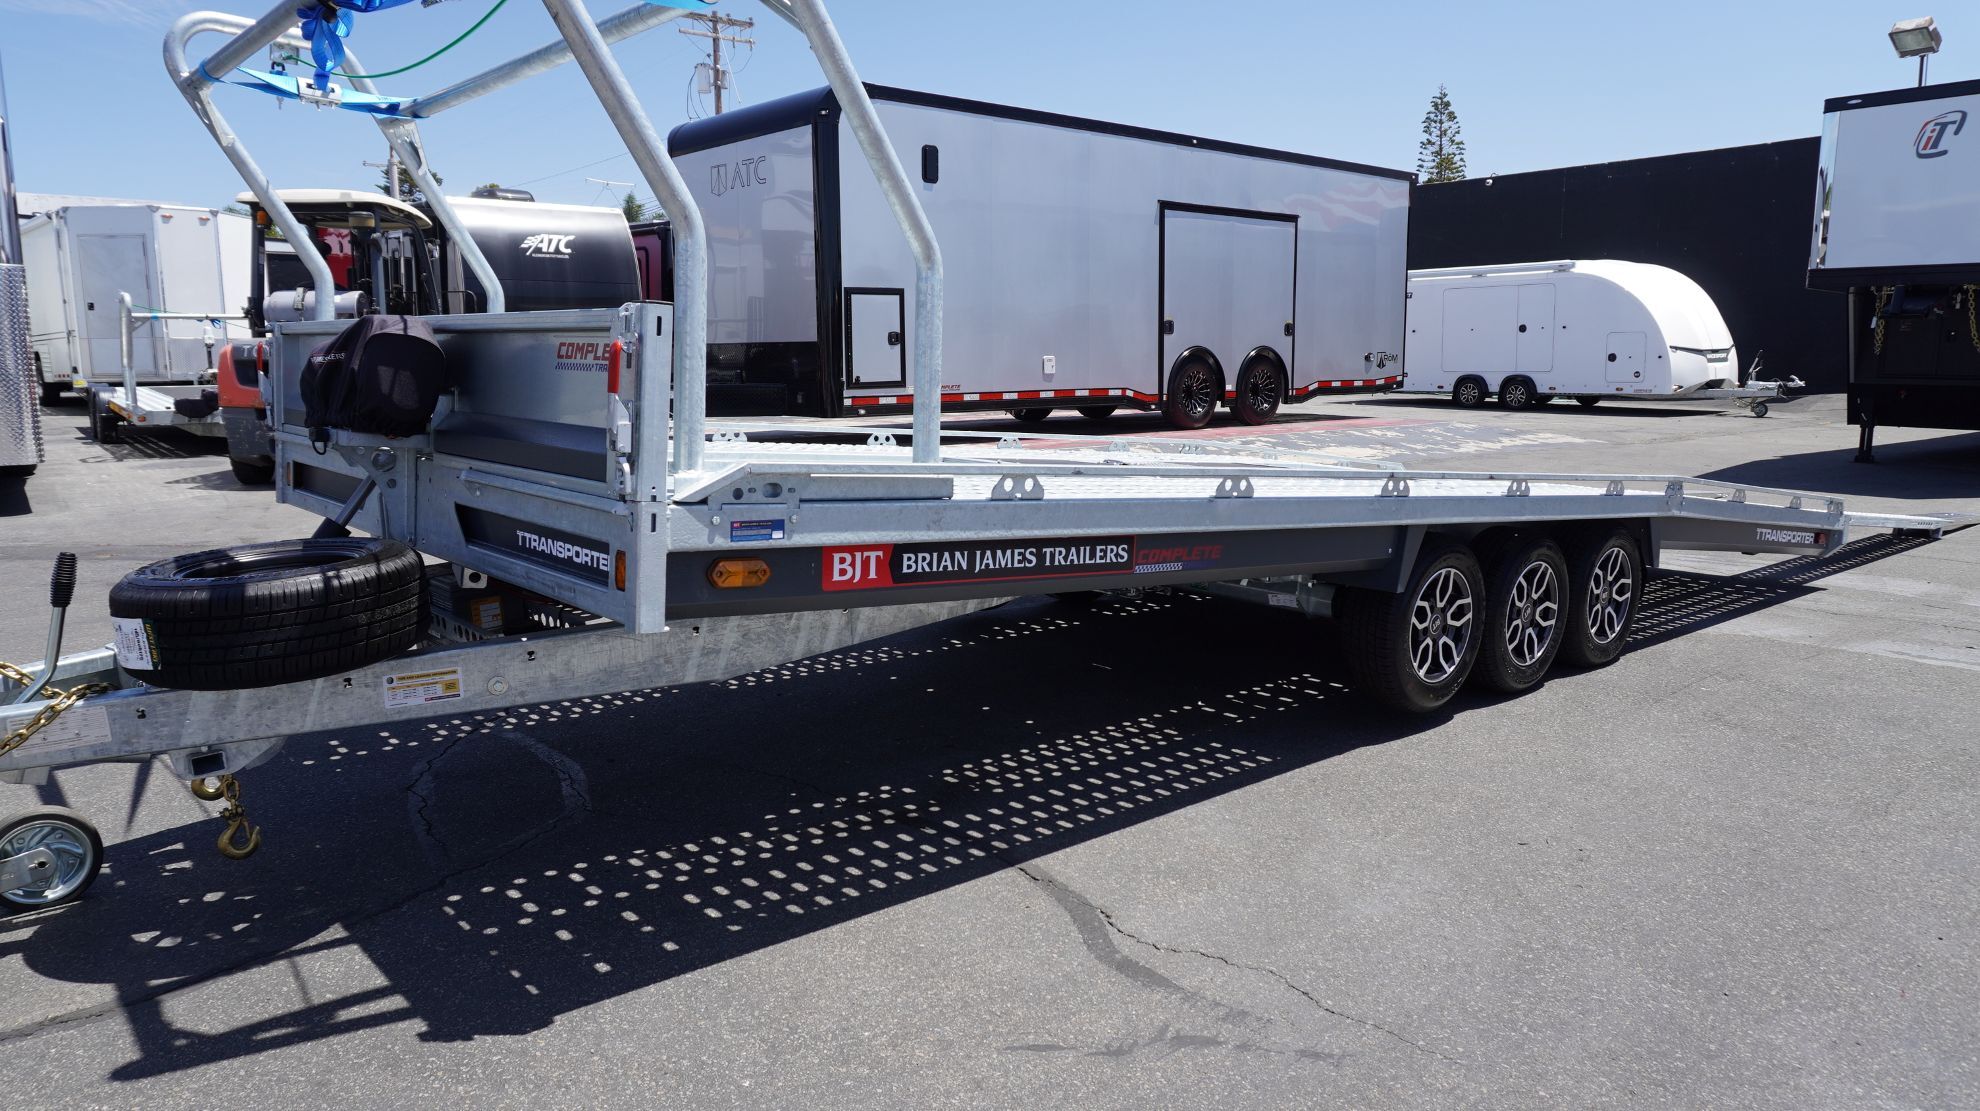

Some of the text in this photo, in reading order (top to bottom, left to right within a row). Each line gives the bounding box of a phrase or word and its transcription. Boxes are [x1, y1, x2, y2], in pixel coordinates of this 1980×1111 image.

[731, 156, 767, 189] ATC
[526, 234, 576, 255] ATC
[557, 342, 610, 361] COMPLE
[517, 530, 609, 572] TTRANSPORTE
[832, 545, 1128, 583] BJT BRIAN JAMES TRAILERS
[1136, 545, 1223, 563] COMPLETE
